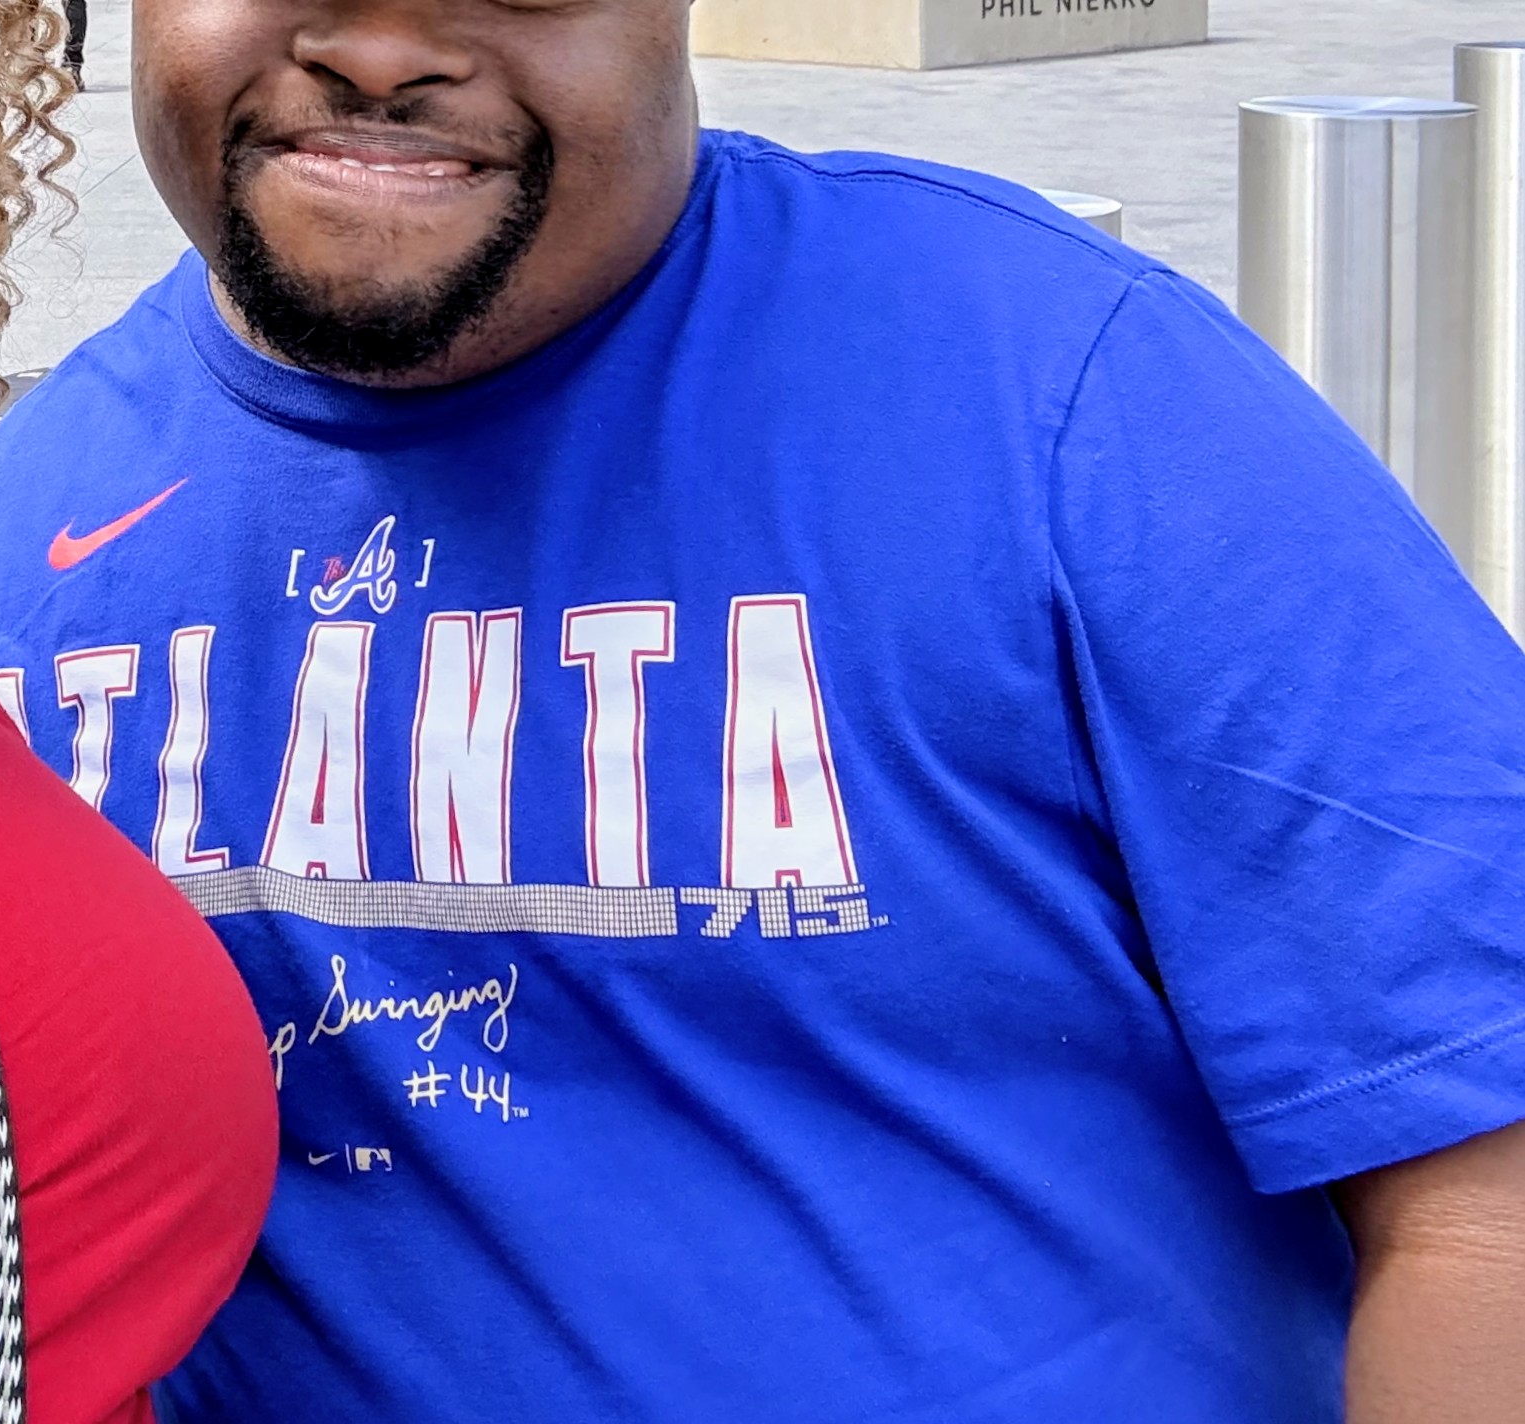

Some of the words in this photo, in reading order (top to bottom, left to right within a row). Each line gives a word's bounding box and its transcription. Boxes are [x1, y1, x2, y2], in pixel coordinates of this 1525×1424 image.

[679, 883, 870, 938] 715
[308, 954, 518, 1053] Swinging
[402, 1060, 511, 1123] #44
